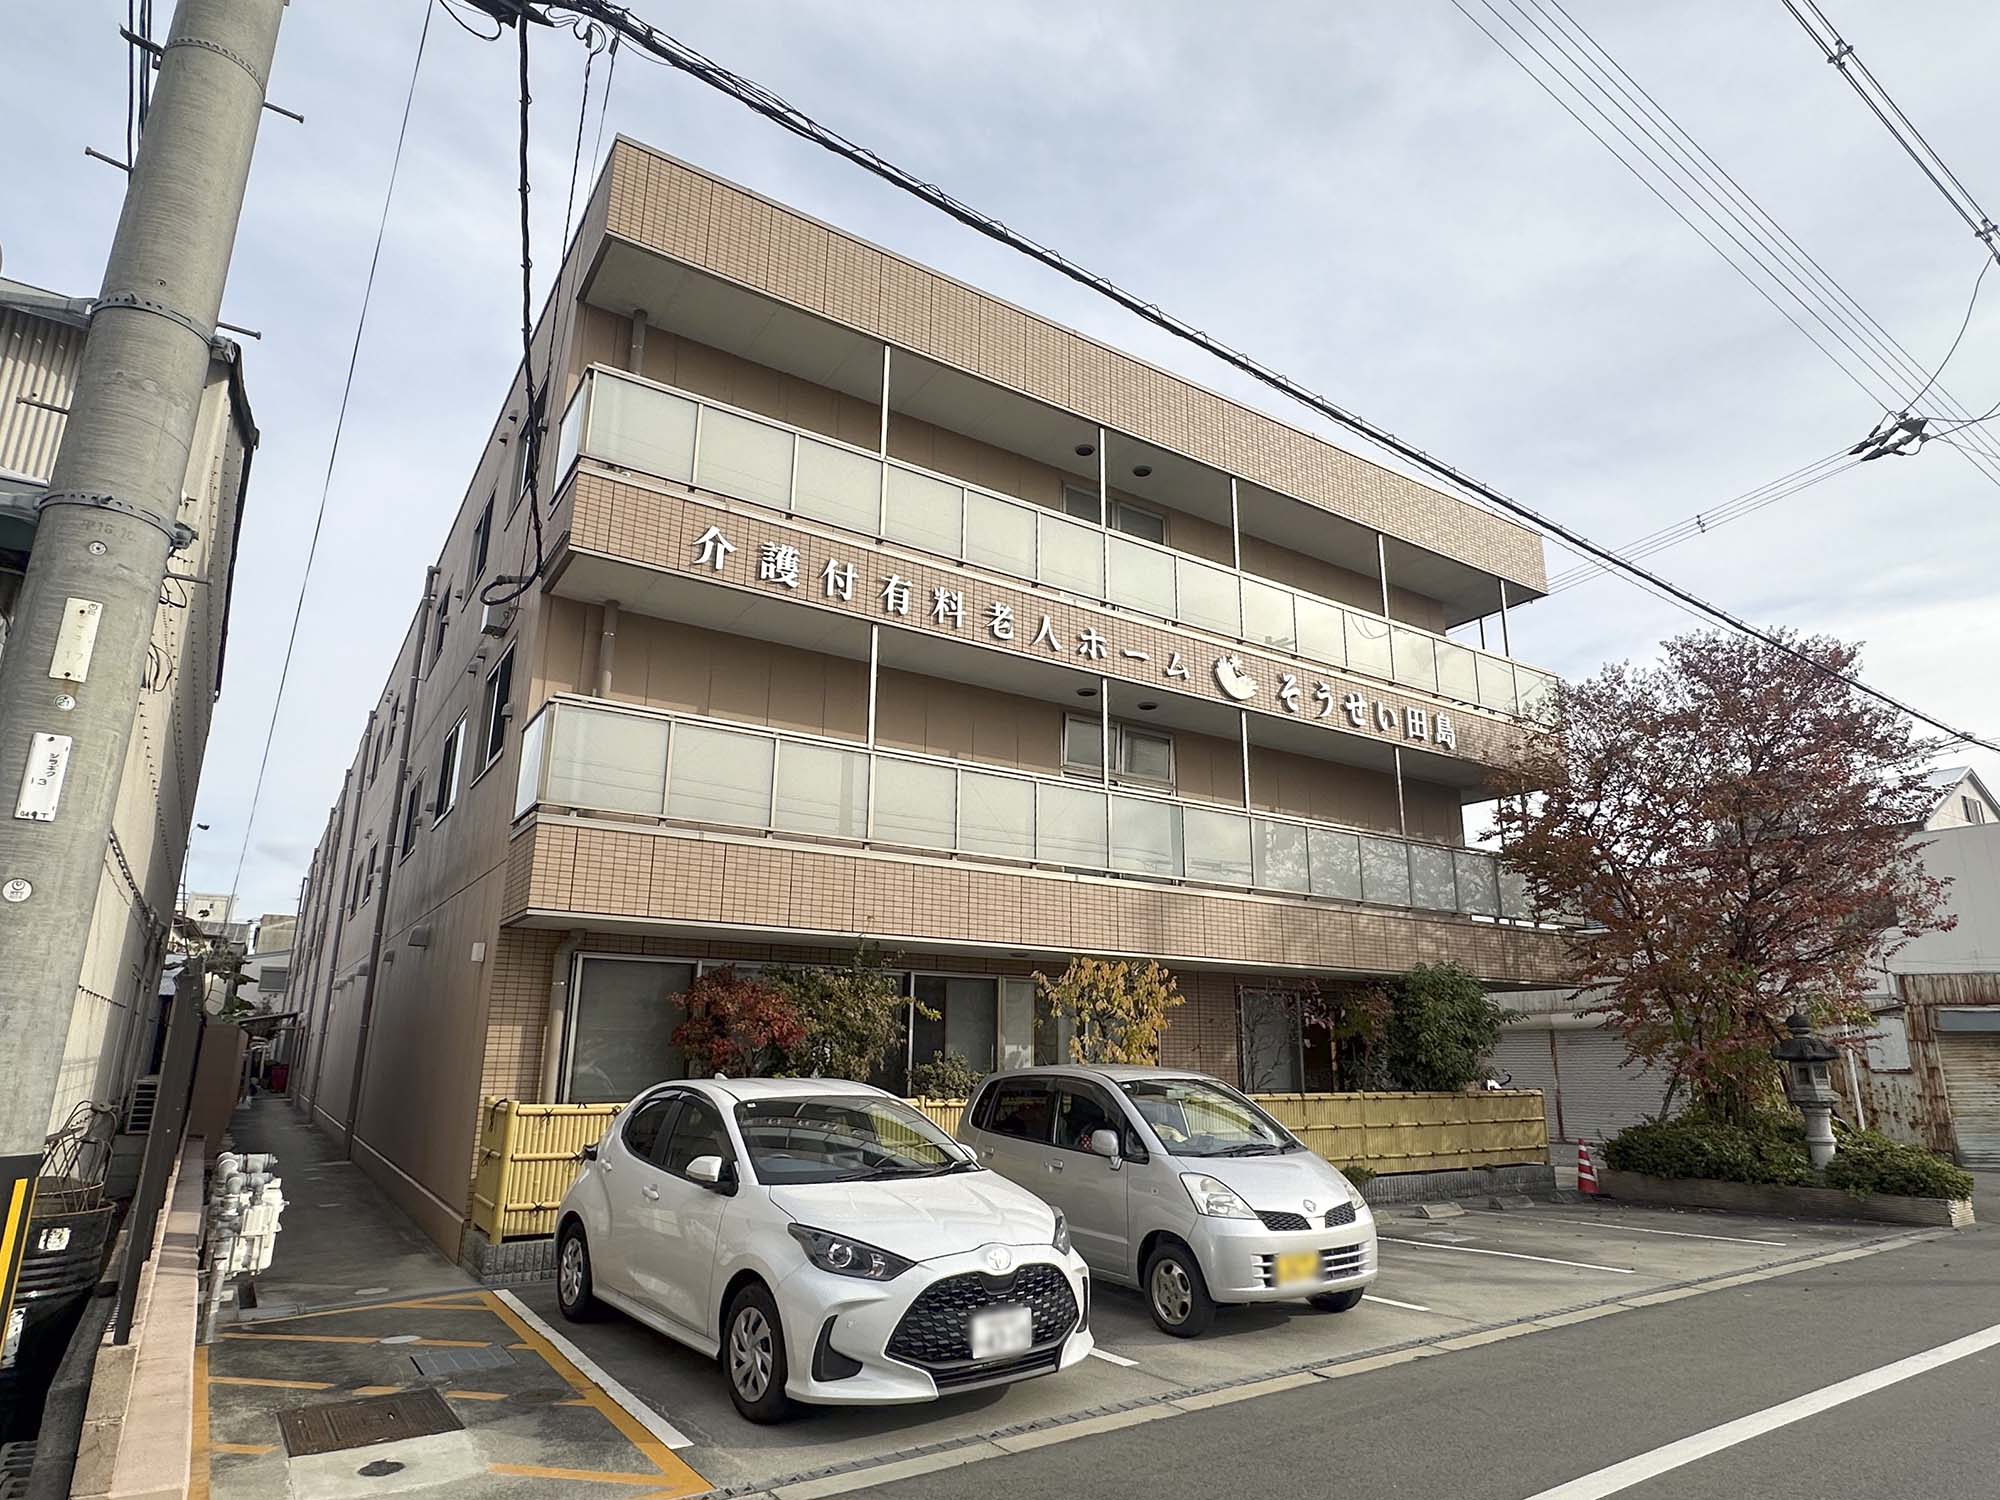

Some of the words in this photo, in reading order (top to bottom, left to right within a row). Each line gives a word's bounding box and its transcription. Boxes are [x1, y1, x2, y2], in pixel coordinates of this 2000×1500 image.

[692, 524, 1191, 681] 介護付有料老人ホーム
[1278, 672, 1457, 751] そうせい田島
